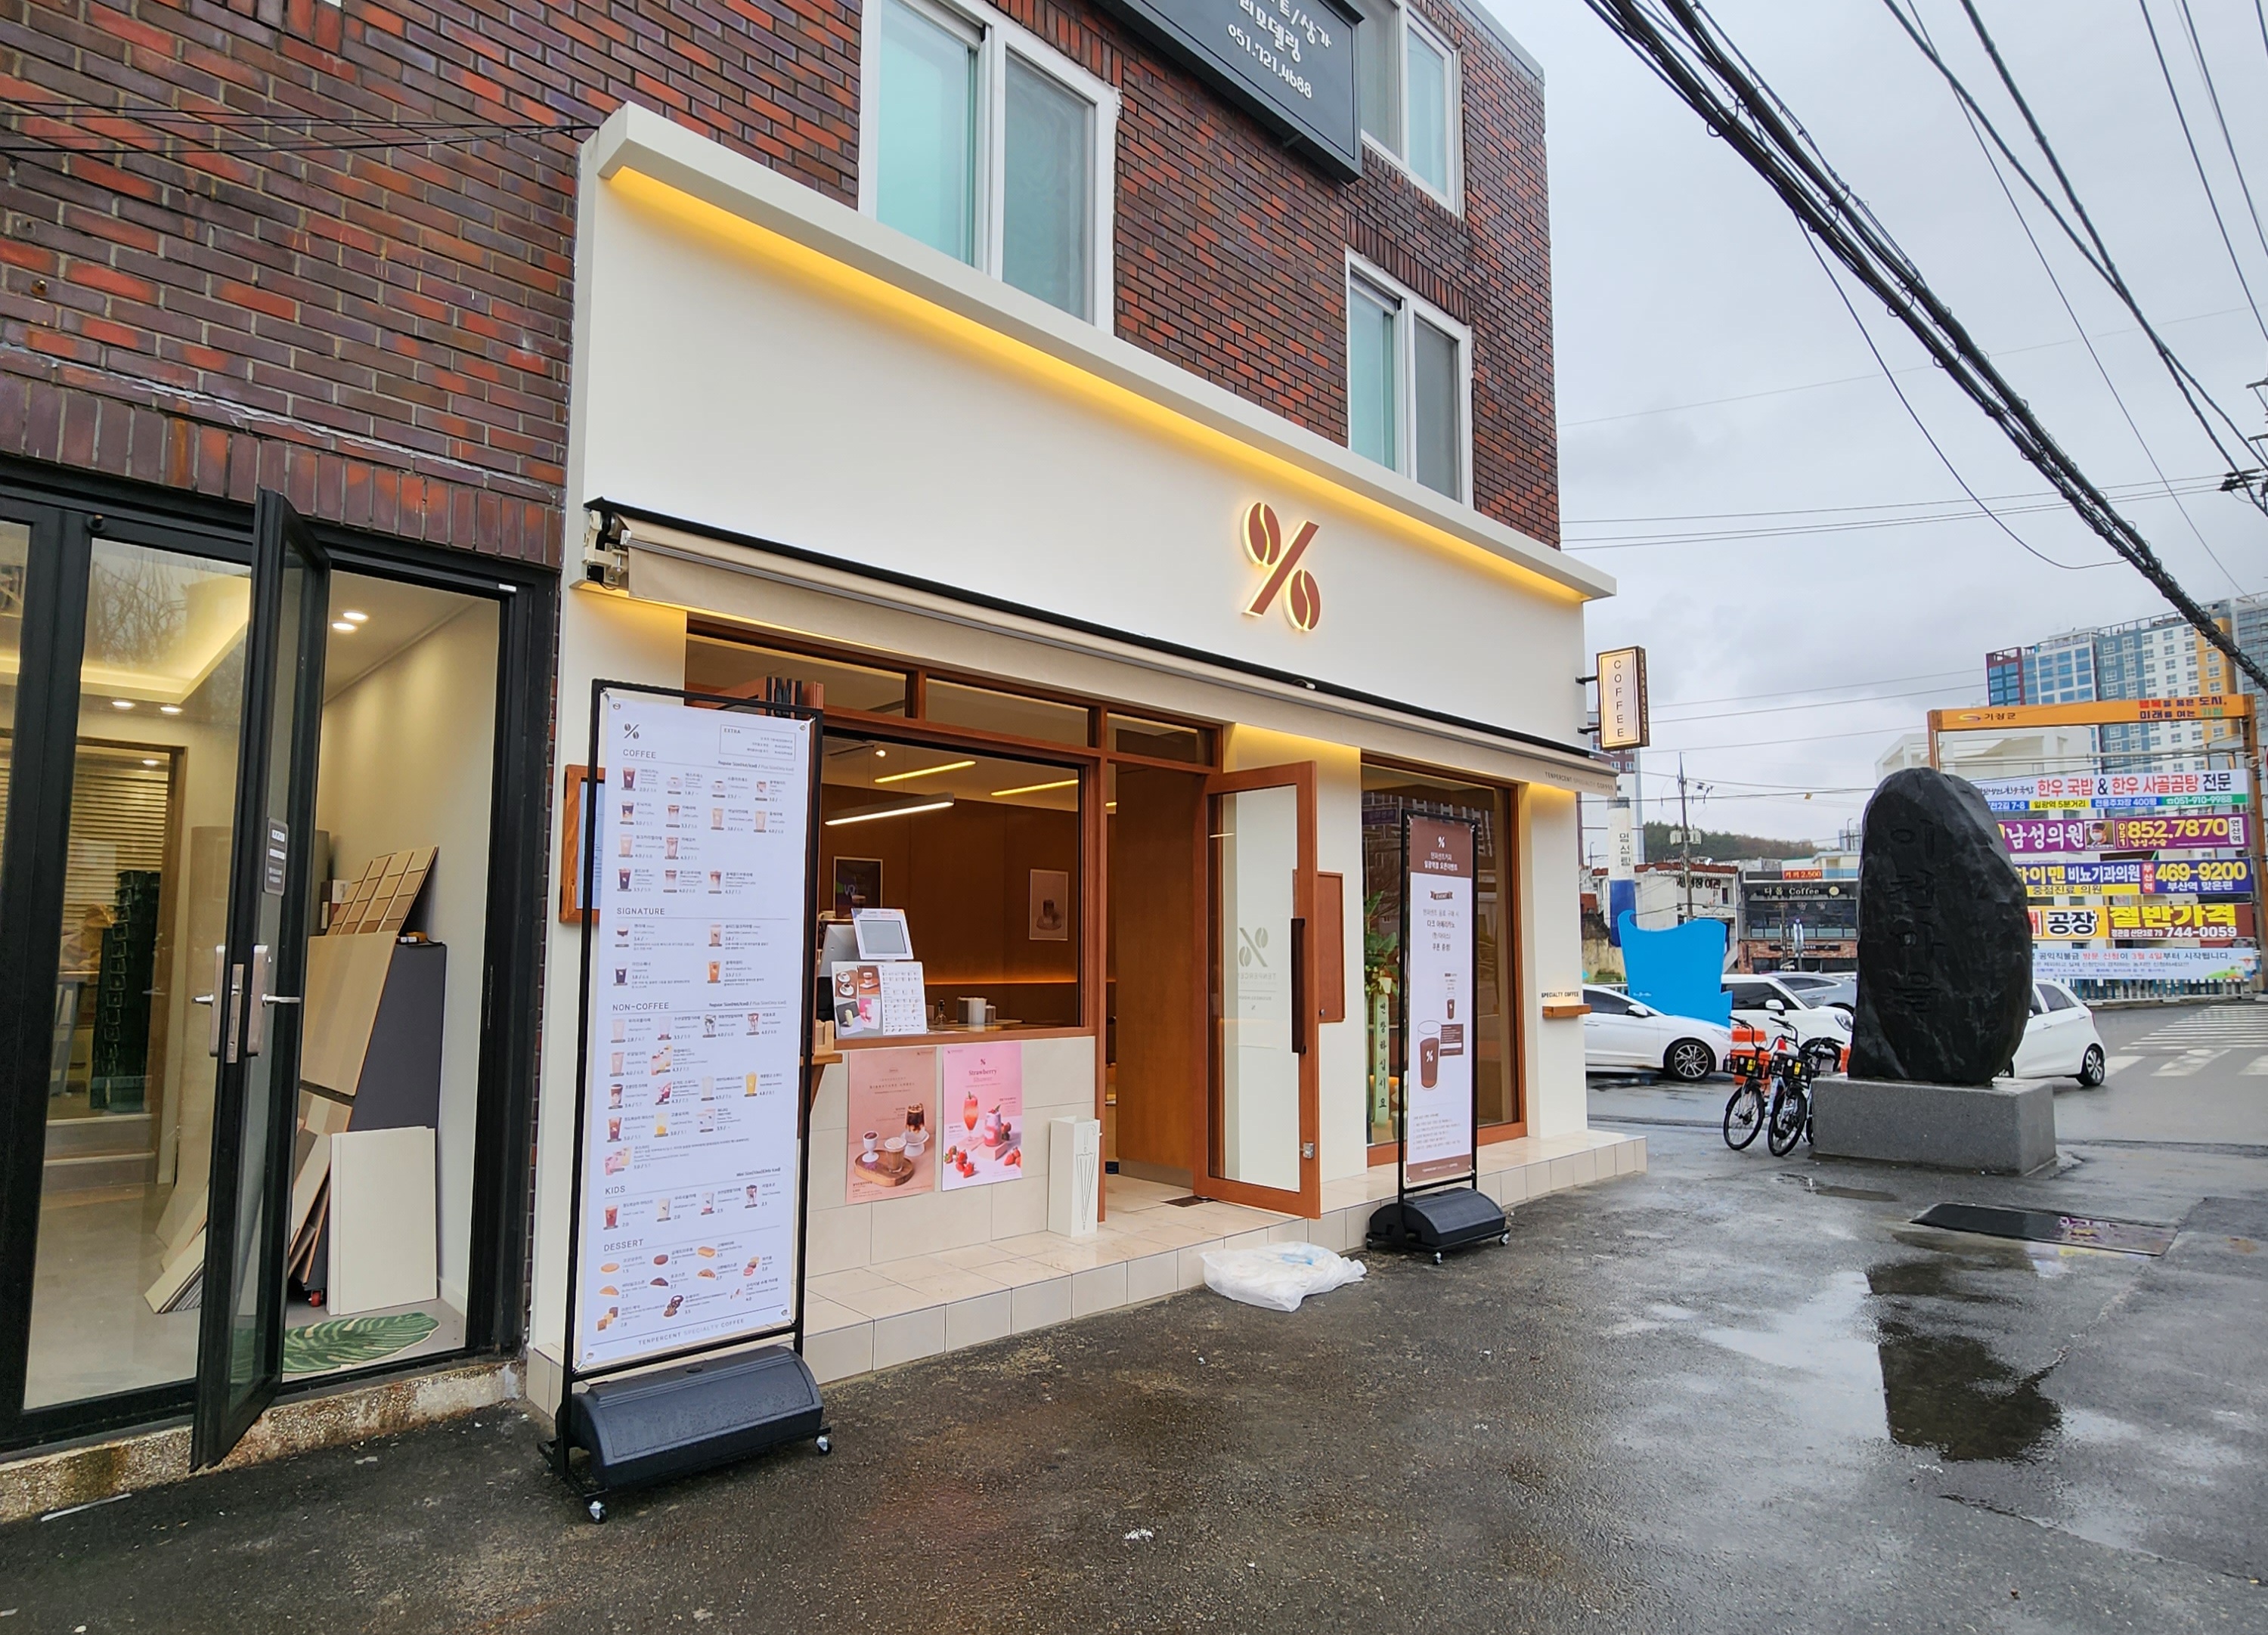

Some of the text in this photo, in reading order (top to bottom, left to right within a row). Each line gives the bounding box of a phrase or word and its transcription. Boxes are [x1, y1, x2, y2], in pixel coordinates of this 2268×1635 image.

[1239, 0, 1301, 63] 리모델링
[1270, 0, 1332, 48] 트/상가
[1227, 23, 1312, 99] 051.721.4688
[1613, 660, 1625, 738] COFFEE
[1984, 712, 2016, 721] 기장군
[622, 748, 656, 759] COFFEE
[1545, 771, 1572, 783] TENPERCENT
[1597, 782, 1613, 791] COFFEE
[2037, 779, 2063, 797] 한우
[2067, 778, 2093, 796] 국밥
[2097, 778, 2108, 795] &
[2112, 776, 2139, 794] 한우
[2143, 775, 2198, 794] 사골곰탕
[2203, 773, 2232, 792] 전문
[1988, 801, 2025, 810] 천2길 7-8
[2006, 822, 2084, 850] 남성의원
[2127, 818, 2229, 839] 852.7870
[2231, 819, 2242, 842] 연산역
[2068, 864, 2141, 883] 비뇨기과의원
[2155, 861, 2247, 881] 469-9200
[1789, 887, 1820, 896] Coffee
[2081, 885, 2102, 894] 의원
[2167, 881, 2233, 891] 부산역 맞은편
[2046, 909, 2097, 935] 공장
[2165, 927, 2237, 937] 744-0059
[612, 1002, 669, 1011] NON-COFFEE
[968, 1068, 997, 1076] Strawberry
[605, 1186, 625, 1194] KIDS
[604, 1239, 644, 1251] DESSERT
[638, 1318, 744, 1345] TENPERCENT SPECIALTY COFFEE
